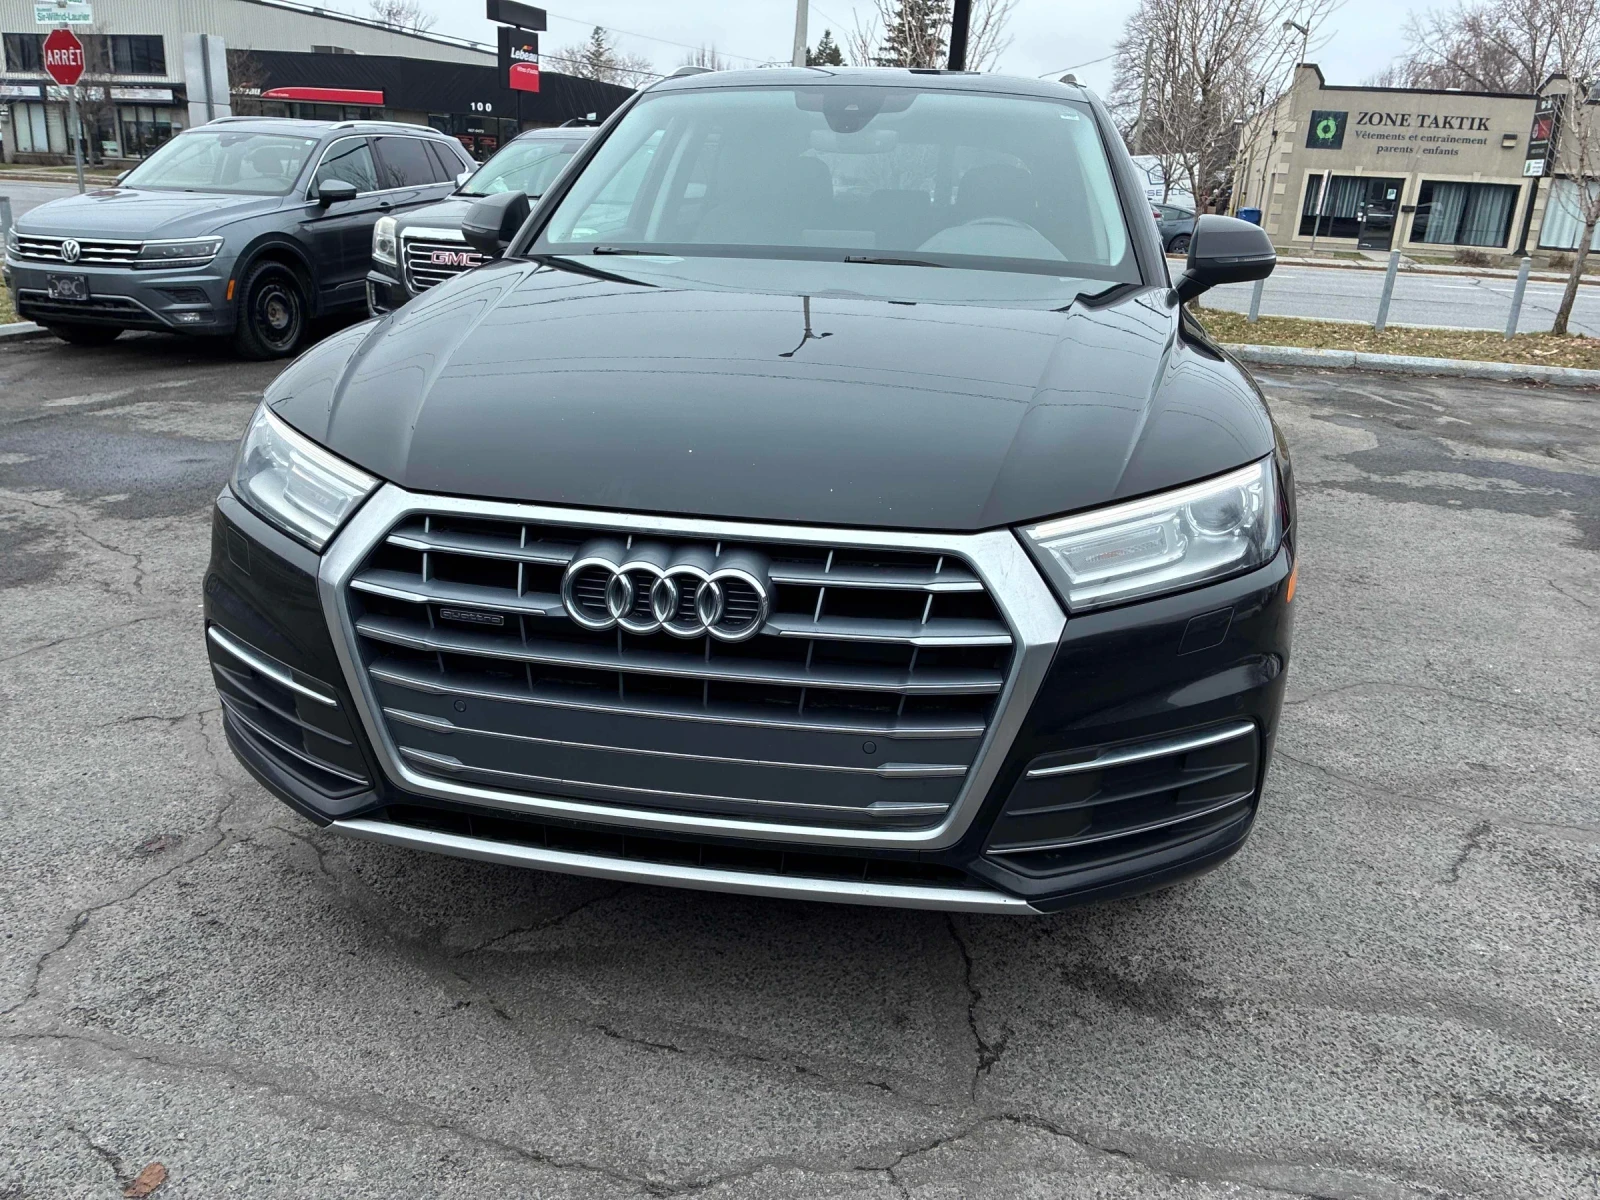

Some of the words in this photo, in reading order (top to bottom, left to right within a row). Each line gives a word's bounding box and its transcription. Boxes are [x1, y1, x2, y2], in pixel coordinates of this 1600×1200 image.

[47, 46, 82, 66] ARRÊT
[511, 46, 538, 62] Lebeau
[470, 102, 492, 112] 100
[1356, 111, 1411, 127] ZONE
[1416, 114, 1491, 131] TAKTIK
[1354, 130, 1406, 141] Vêtements
[1408, 134, 1418, 142] et
[1420, 134, 1487, 145] entraînement
[1376, 145, 1414, 154] parents
[1423, 146, 1459, 156] enfants
[431, 251, 482, 267] GMC
